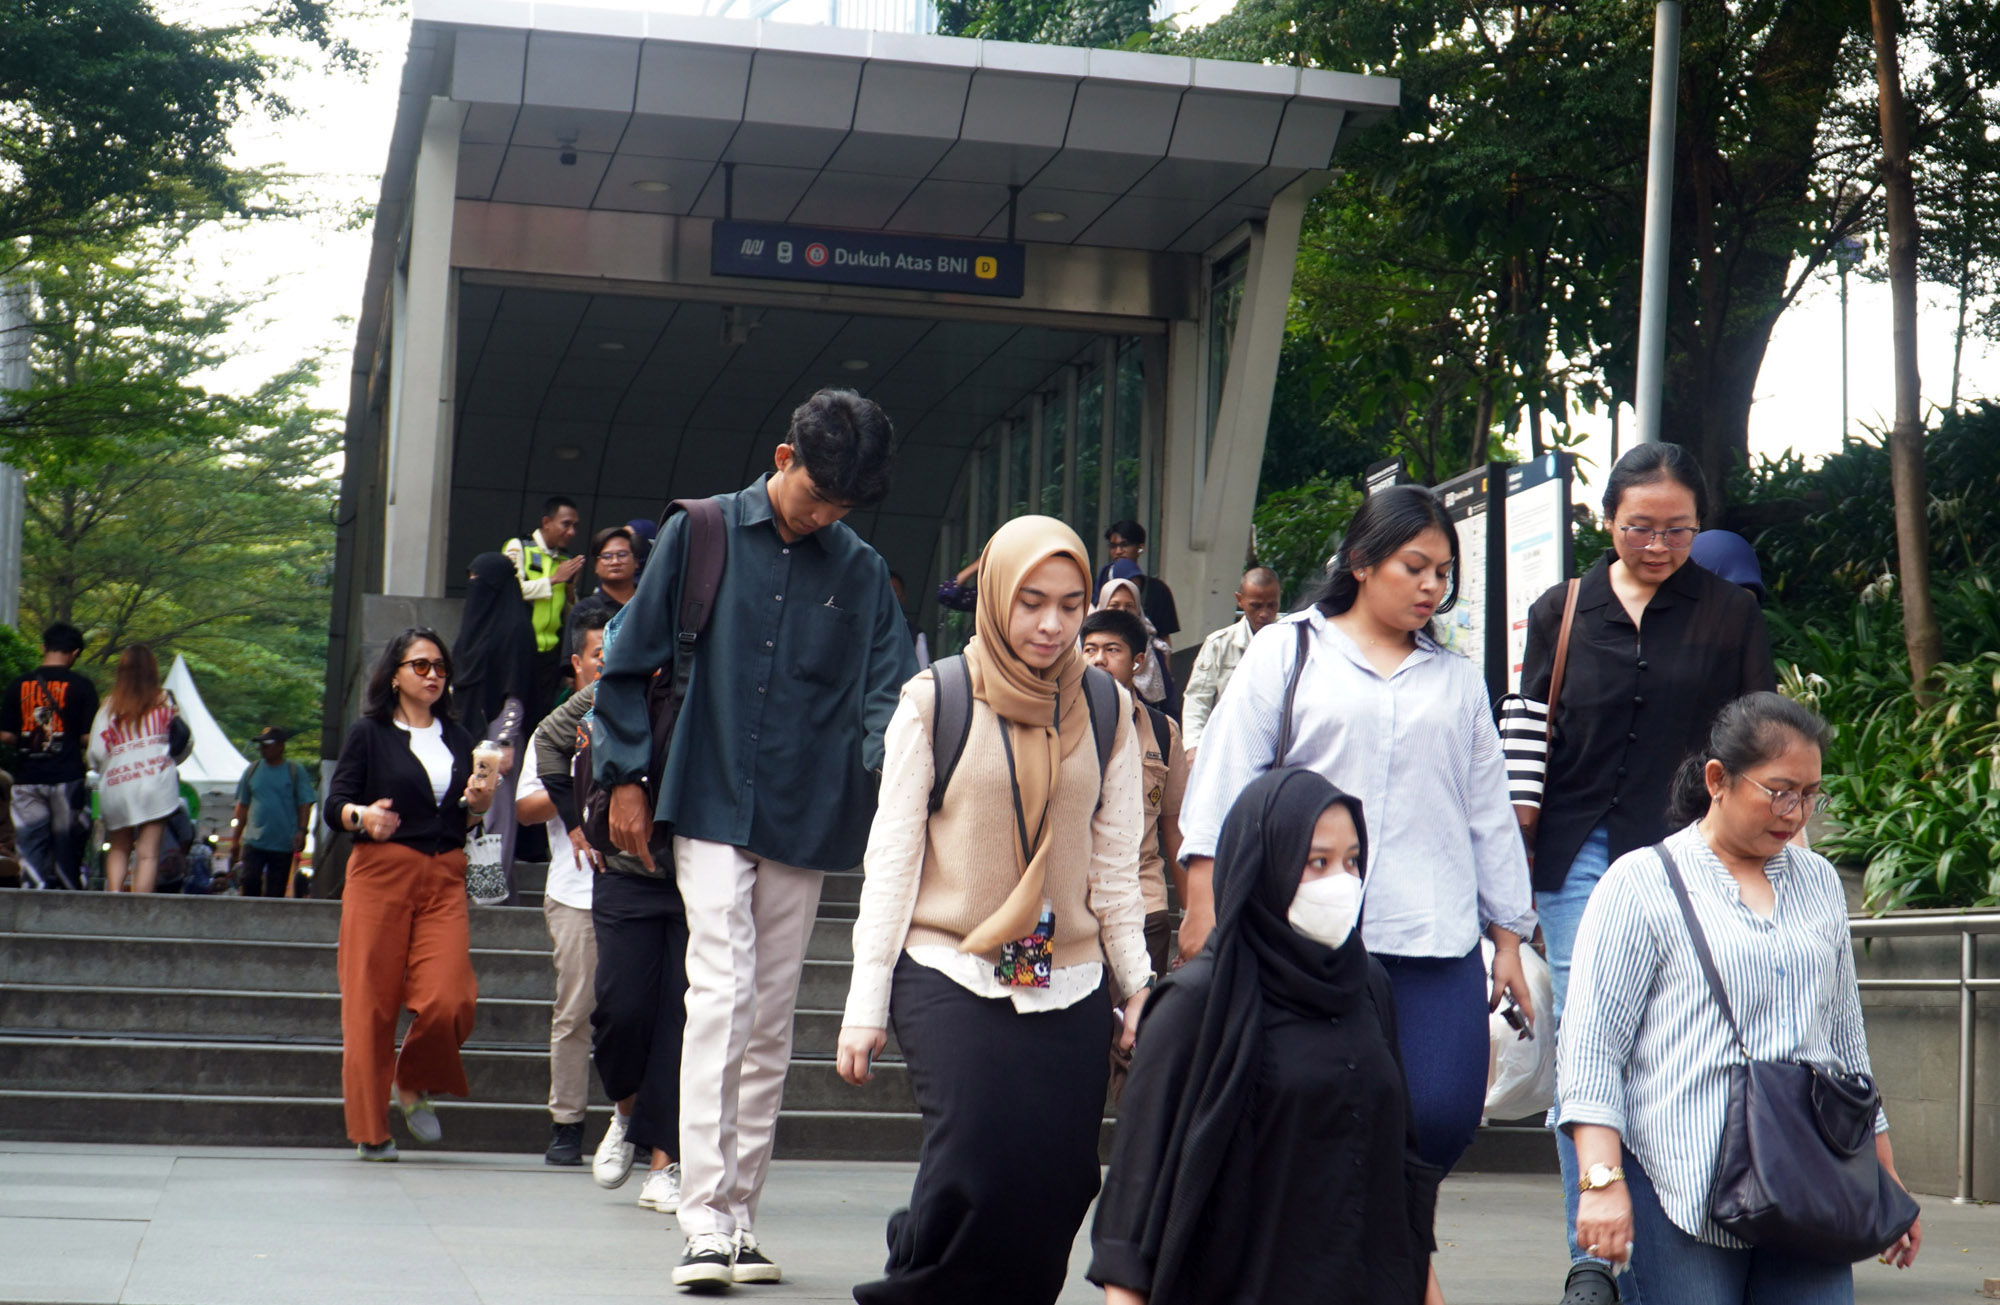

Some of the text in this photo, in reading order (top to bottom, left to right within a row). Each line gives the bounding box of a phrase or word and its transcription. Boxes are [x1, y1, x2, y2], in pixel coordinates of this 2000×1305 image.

[834, 247, 890, 268] Dukuh
[895, 253, 932, 272] Atas
[937, 256, 968, 274] BNI
[981, 261, 991, 273] D
